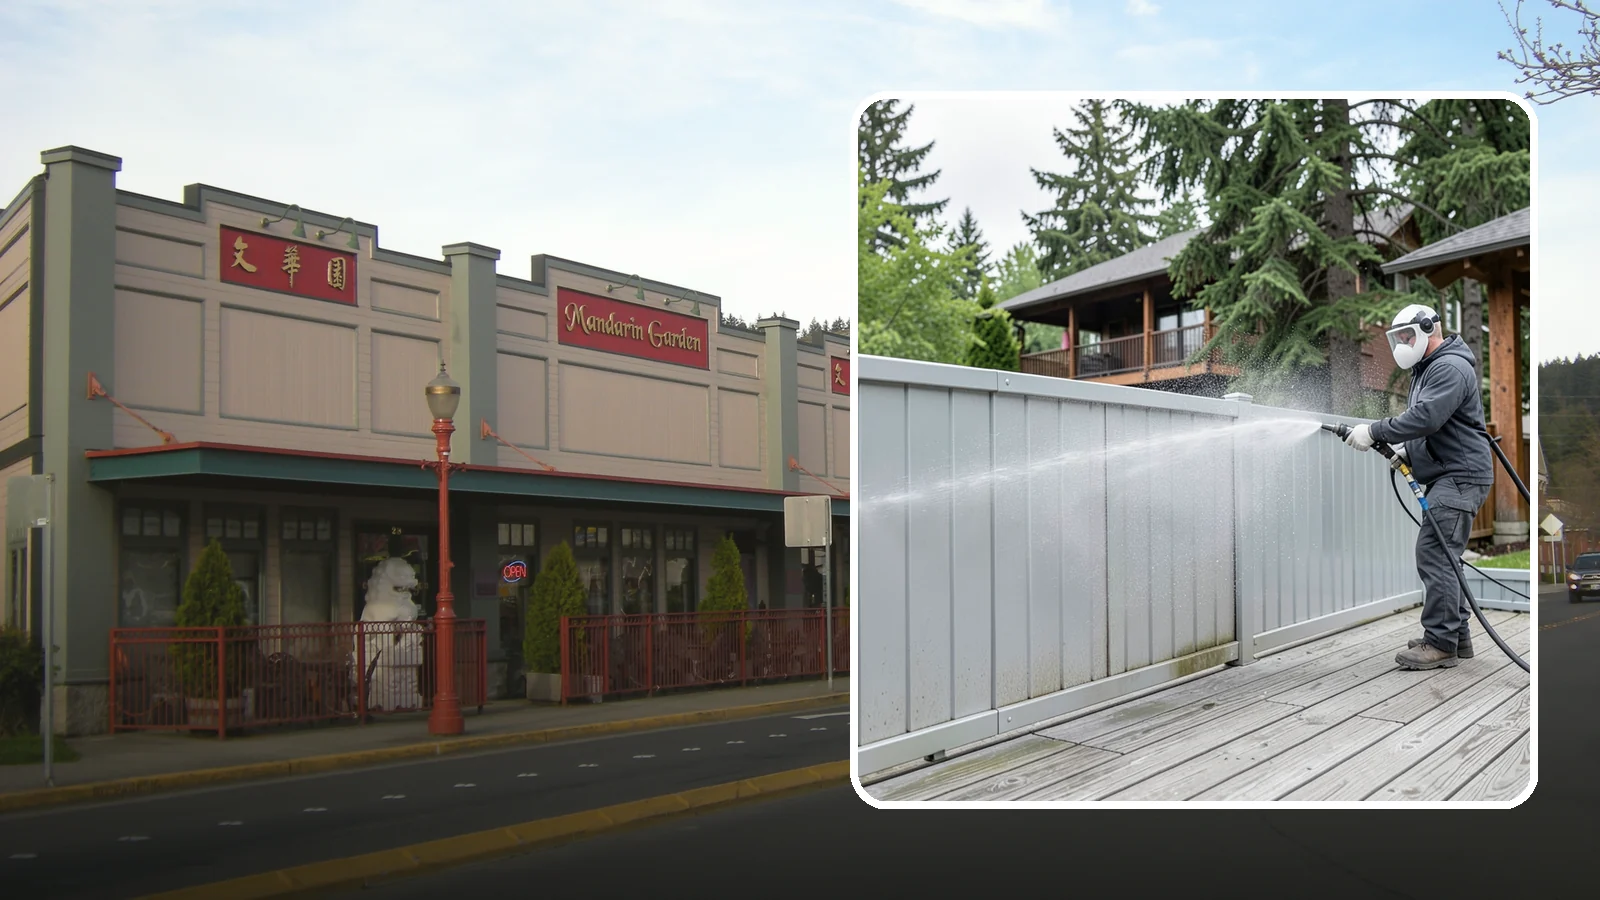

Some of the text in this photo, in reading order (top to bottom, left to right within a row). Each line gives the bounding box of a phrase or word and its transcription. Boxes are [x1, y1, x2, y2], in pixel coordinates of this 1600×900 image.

[230, 235, 346, 291] 文華園
[564, 302, 702, 352] Mandarin Garden
[503, 565, 527, 578] OPEN
